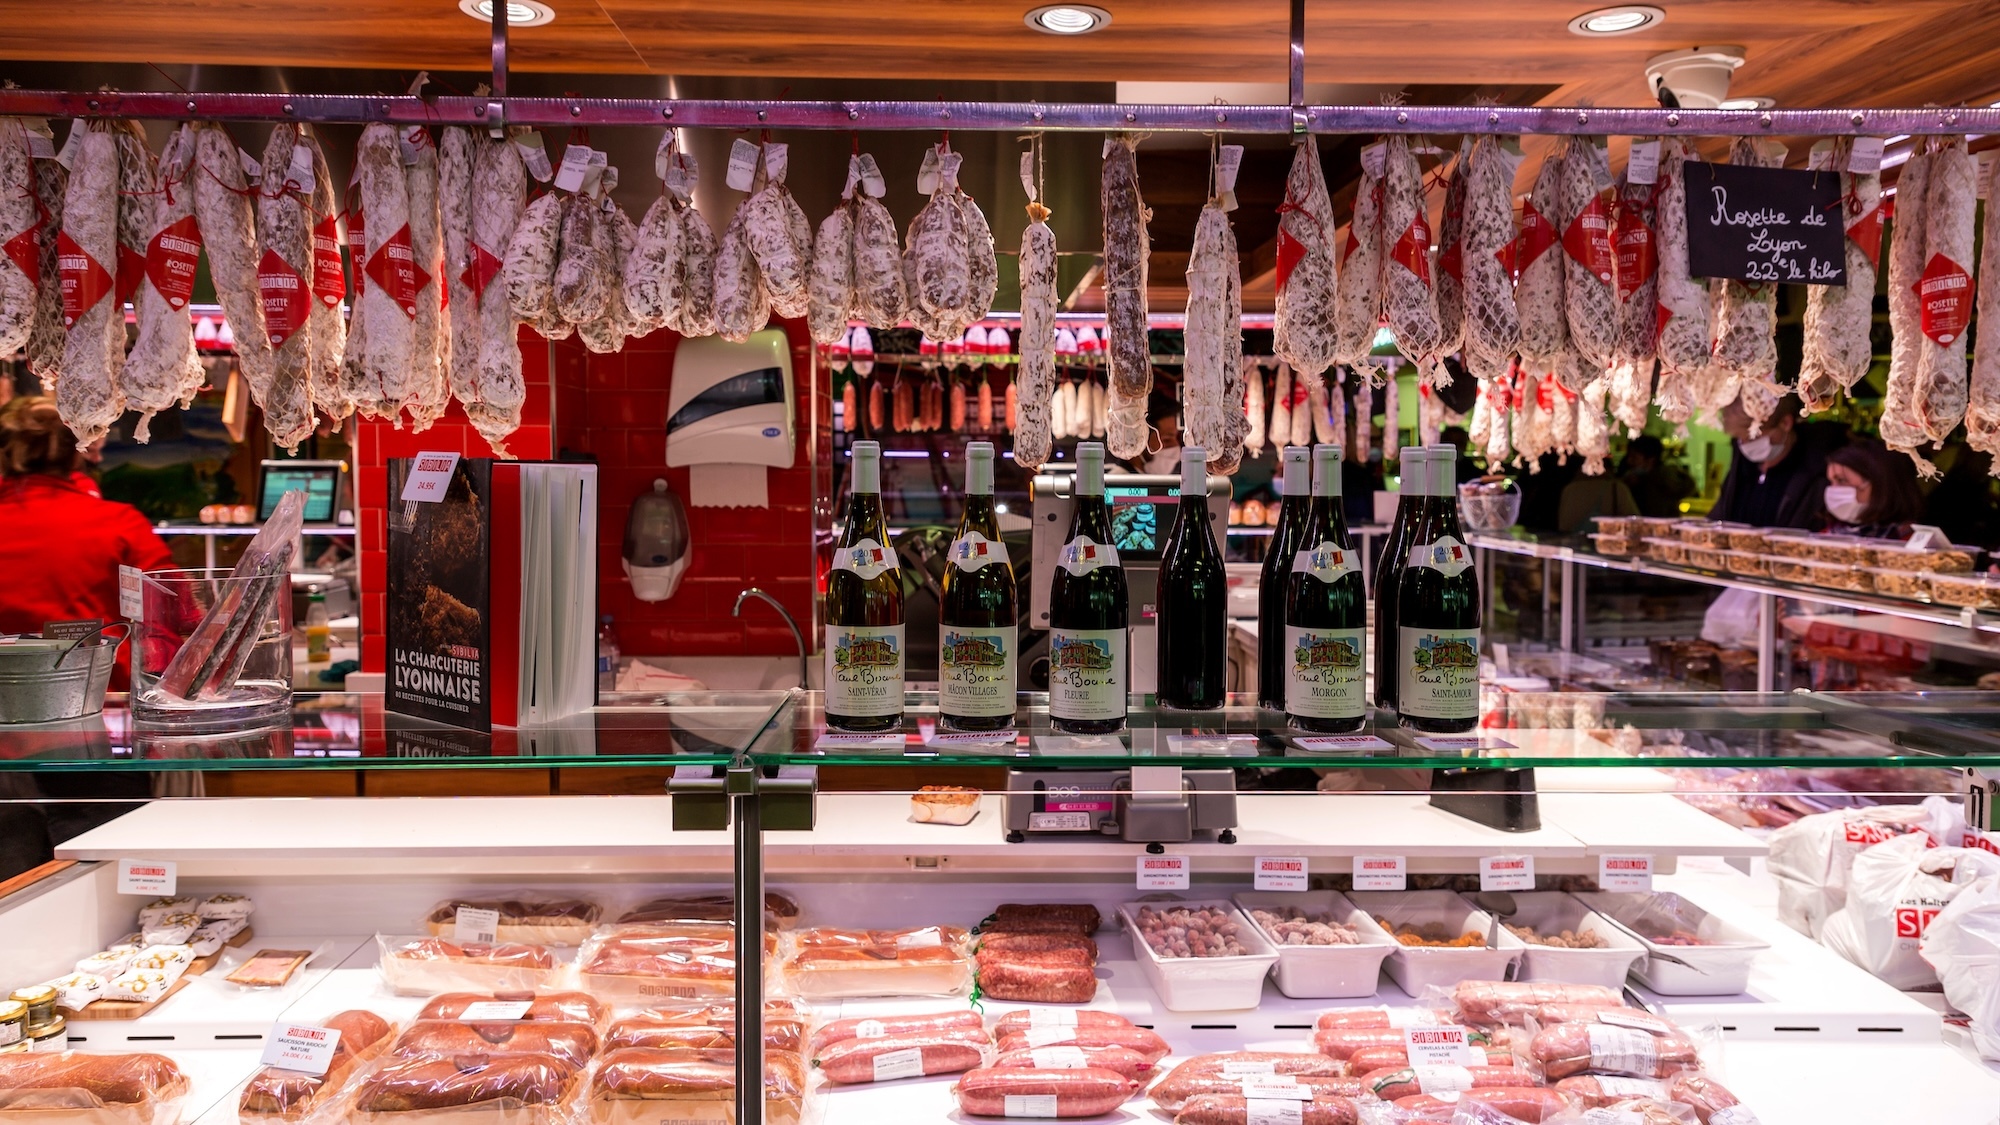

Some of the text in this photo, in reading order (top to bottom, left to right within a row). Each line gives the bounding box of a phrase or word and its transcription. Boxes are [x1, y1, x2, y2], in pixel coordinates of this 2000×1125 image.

[1710, 186, 1827, 227] Rosette de
[1747, 228, 1807, 263] Lyon
[1787, 259, 1805, 280] le
[1808, 257, 1842, 280] kilo
[1927, 297, 1958, 311] ROSETTE
[418, 459, 452, 472] SIBILIA
[452, 644, 480, 660] SIBILIA
[395, 648, 480, 678] LA CHARCUTERIE
[395, 665, 480, 704] LYONNAISE
[969, 686, 998, 696] VILLAGES
[1064, 689, 1090, 700] FLEURIE
[1312, 687, 1347, 697] MORGON
[402, 692, 424, 704] RECETTES
[425, 697, 438, 707] POUR
[439, 700, 445, 708] LA
[446, 702, 470, 713] CUISINER
[639, 985, 696, 998] SIBILIA
[287, 1027, 327, 1041] SIBILIA
[1411, 1031, 1463, 1043] SIBILIA
[277, 1037, 306, 1047] SAUCISSON
